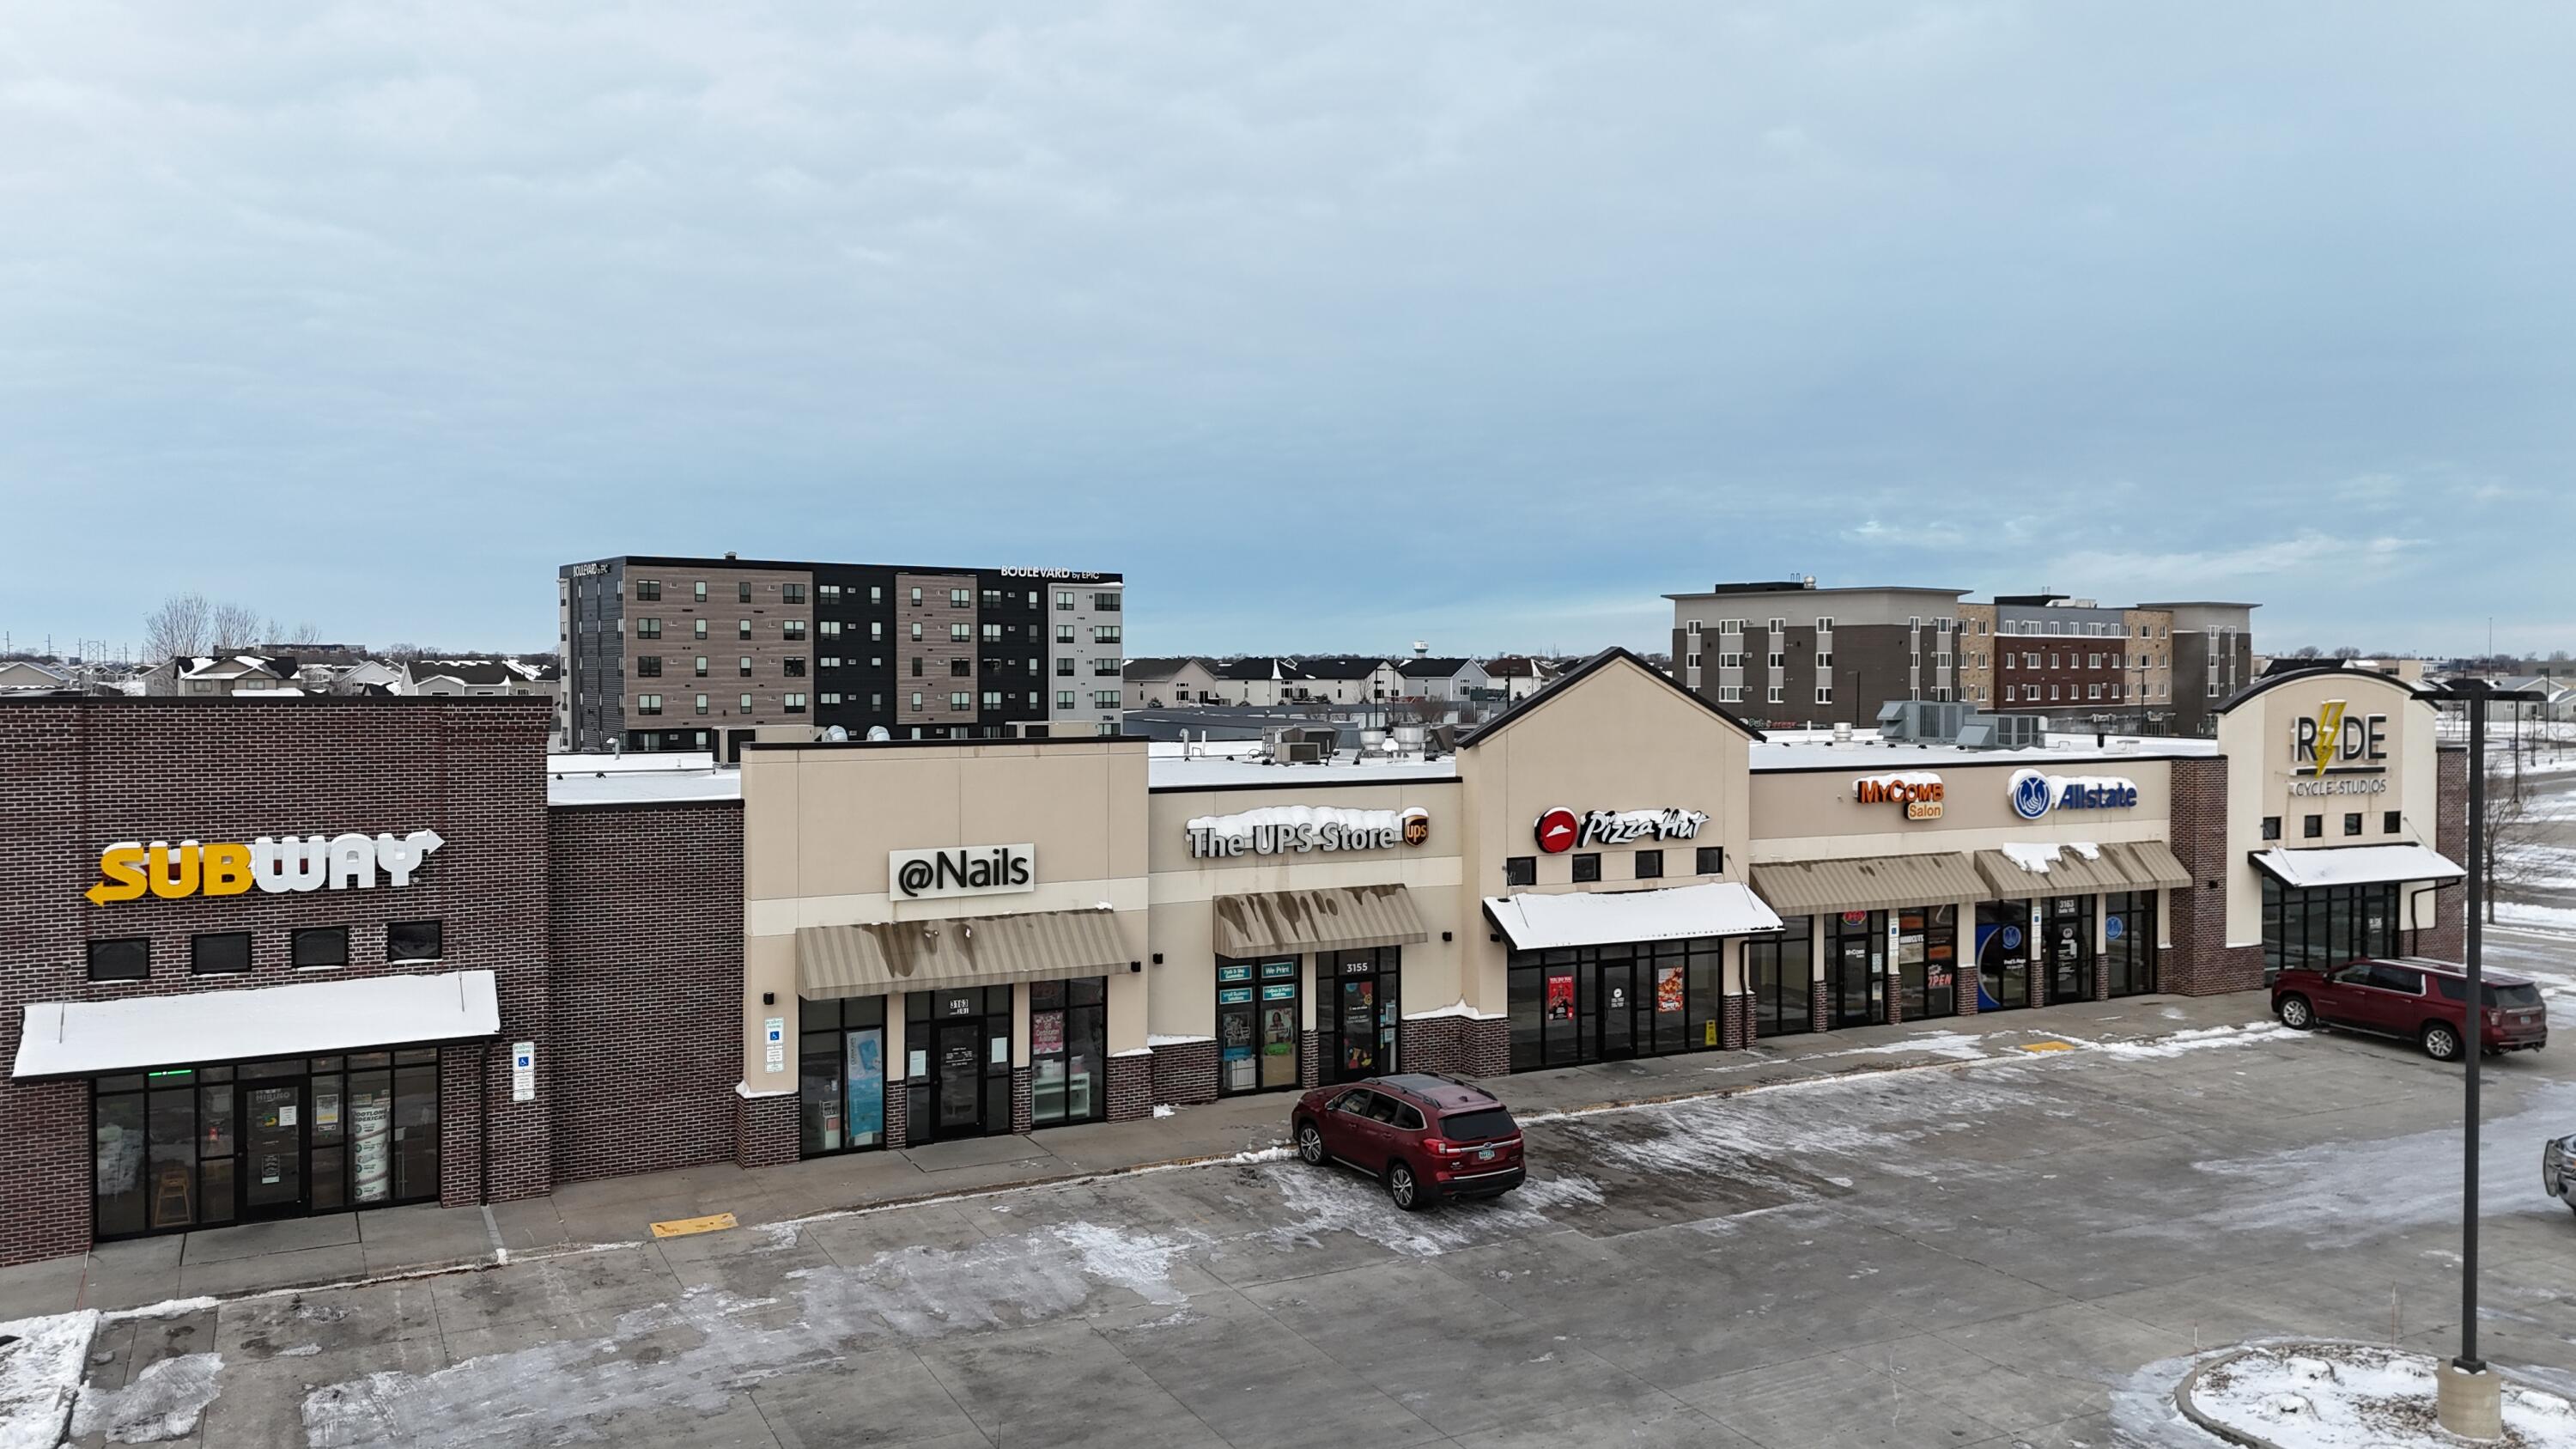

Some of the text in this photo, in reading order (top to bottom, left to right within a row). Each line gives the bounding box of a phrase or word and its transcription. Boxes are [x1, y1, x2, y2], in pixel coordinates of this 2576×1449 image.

[1000, 565, 1100, 580] BOULEVARD by EPIC
[2057, 782, 2137, 810] Allstate
[2296, 779, 2386, 796] CYCLE STUDIOS
[1909, 804, 1941, 818] Salon
[1406, 824, 1427, 843] ups
[1582, 809, 1710, 848] Pizza Hut
[1189, 822, 1395, 858] The UPS Store
[83, 828, 447, 907] SUBWAY
[898, 848, 1030, 898] @Nails
[1265, 965, 1290, 975] We Print
[1346, 962, 1368, 973] 3155
